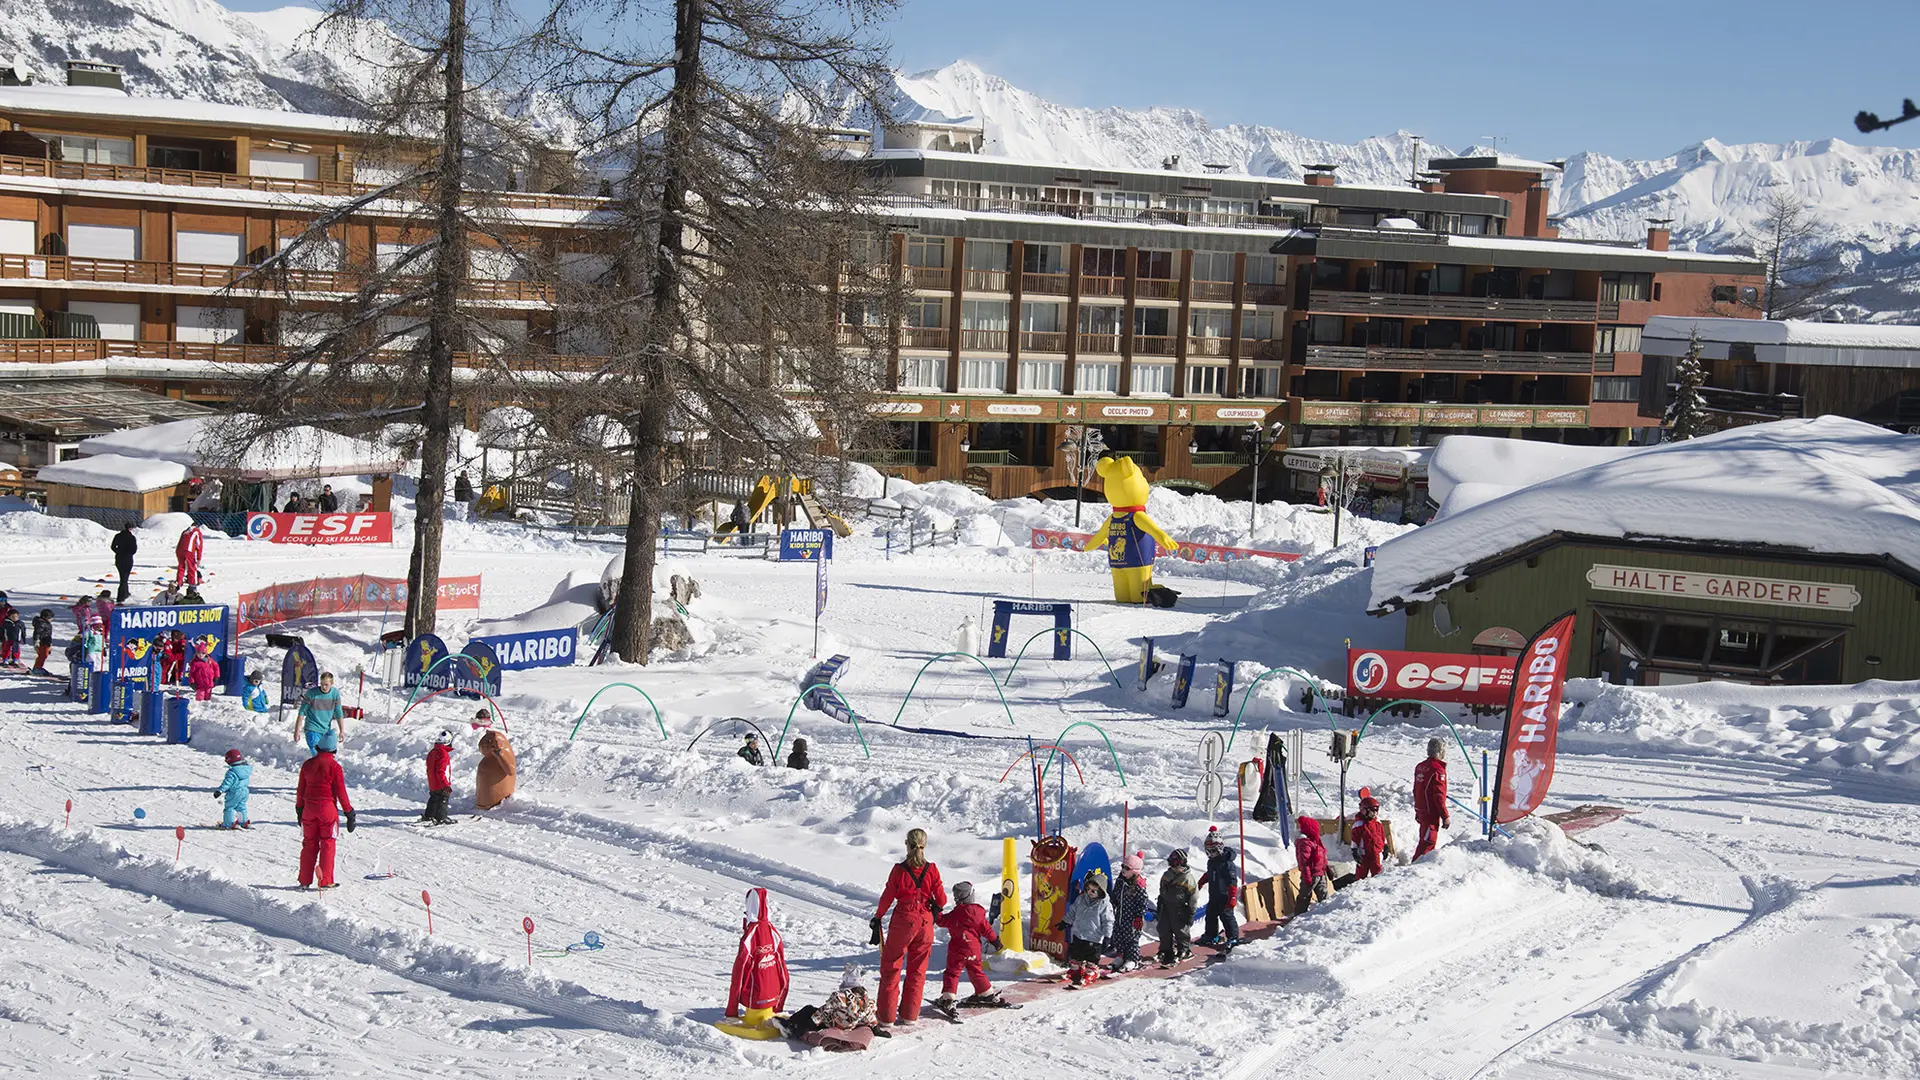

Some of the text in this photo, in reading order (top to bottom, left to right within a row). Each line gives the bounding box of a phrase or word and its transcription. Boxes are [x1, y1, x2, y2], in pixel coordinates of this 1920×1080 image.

[1287, 458, 1295, 466] LE
[289, 515, 377, 535] ESF
[339, 535, 378, 543] FRANÇAIS
[790, 531, 824, 542] HARIBO
[1012, 602, 1054, 611] HARIBO
[121, 607, 222, 629] HARIBO KIDS SNOW
[498, 635, 572, 665] HARIBO
[117, 666, 148, 678] HARIBO
[1396, 662, 1498, 692] esf
[406, 672, 447, 690] HARIBO
[1518, 637, 1559, 742] HARIBO
[1030, 938, 1063, 955] HARIBO
